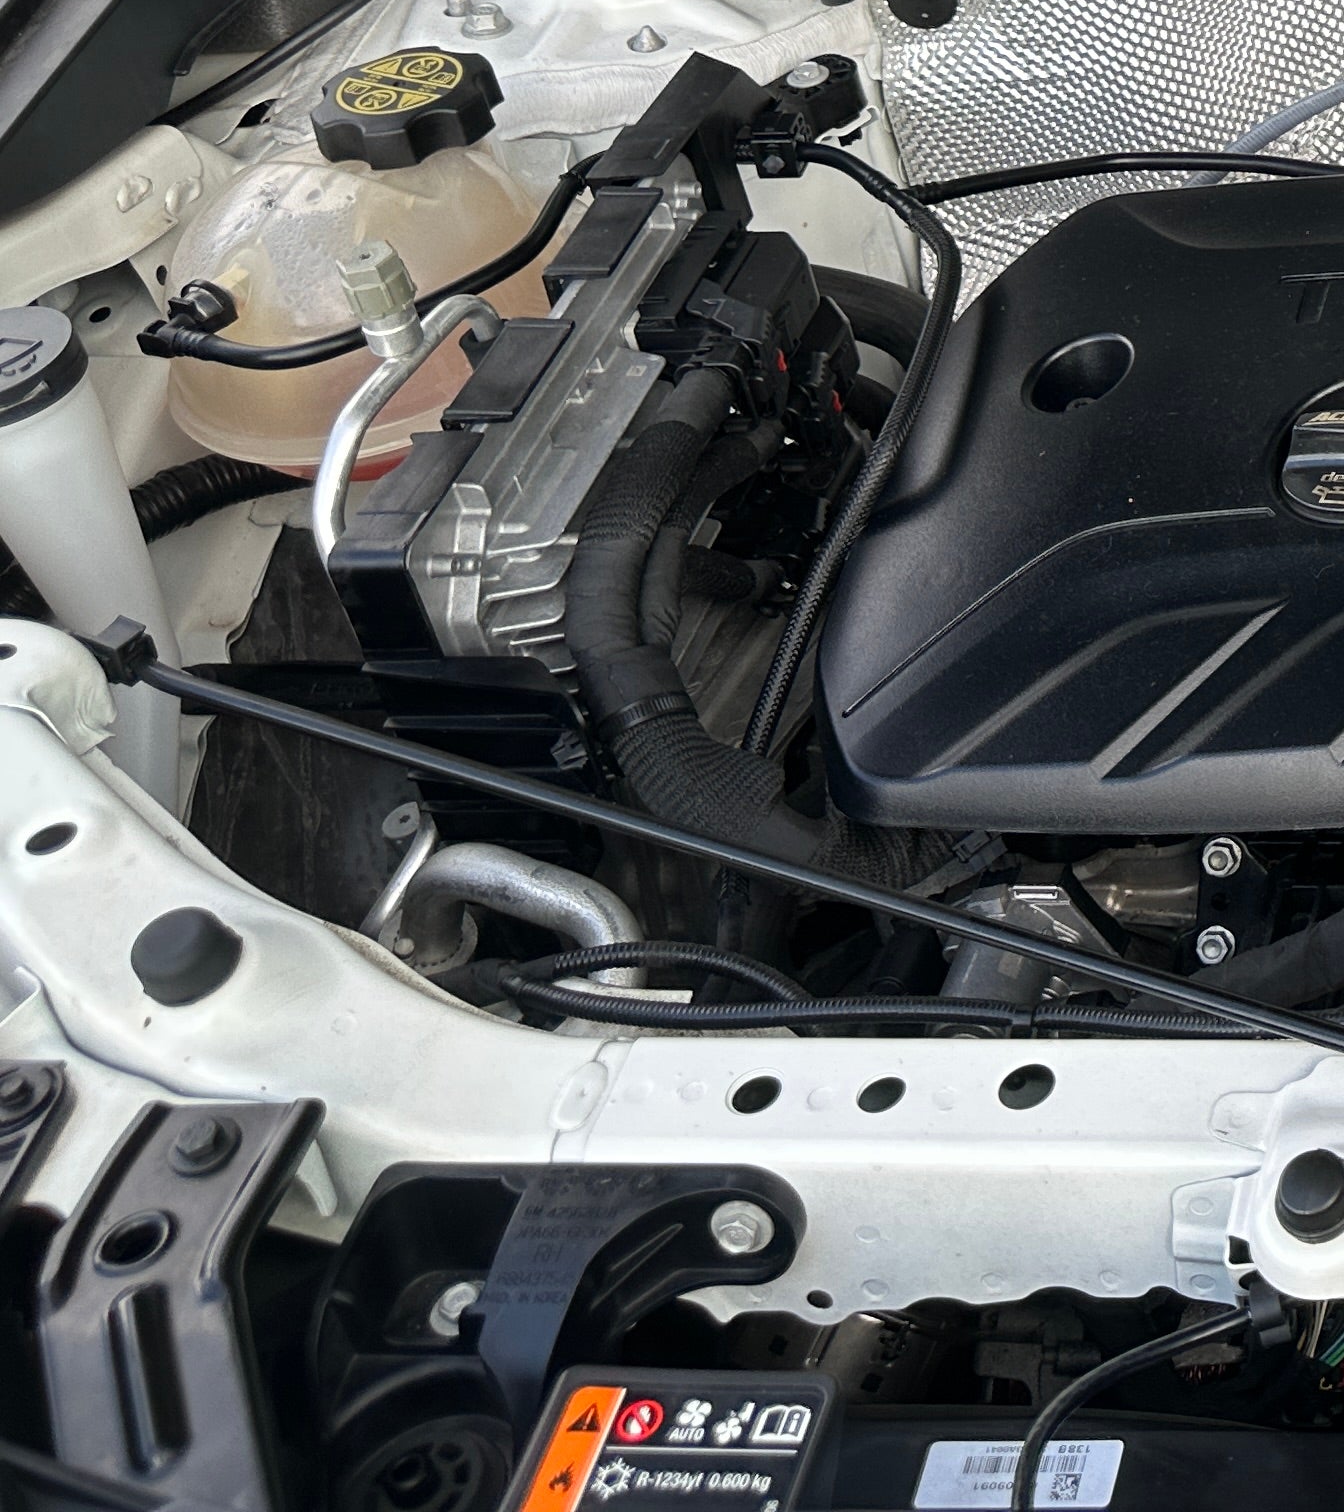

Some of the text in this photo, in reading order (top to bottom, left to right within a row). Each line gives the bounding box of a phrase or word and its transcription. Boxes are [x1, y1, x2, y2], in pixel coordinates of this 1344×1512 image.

[667, 1427, 706, 1441] AUTO
[635, 1470, 772, 1494] R-1234yf 0.600 kg
